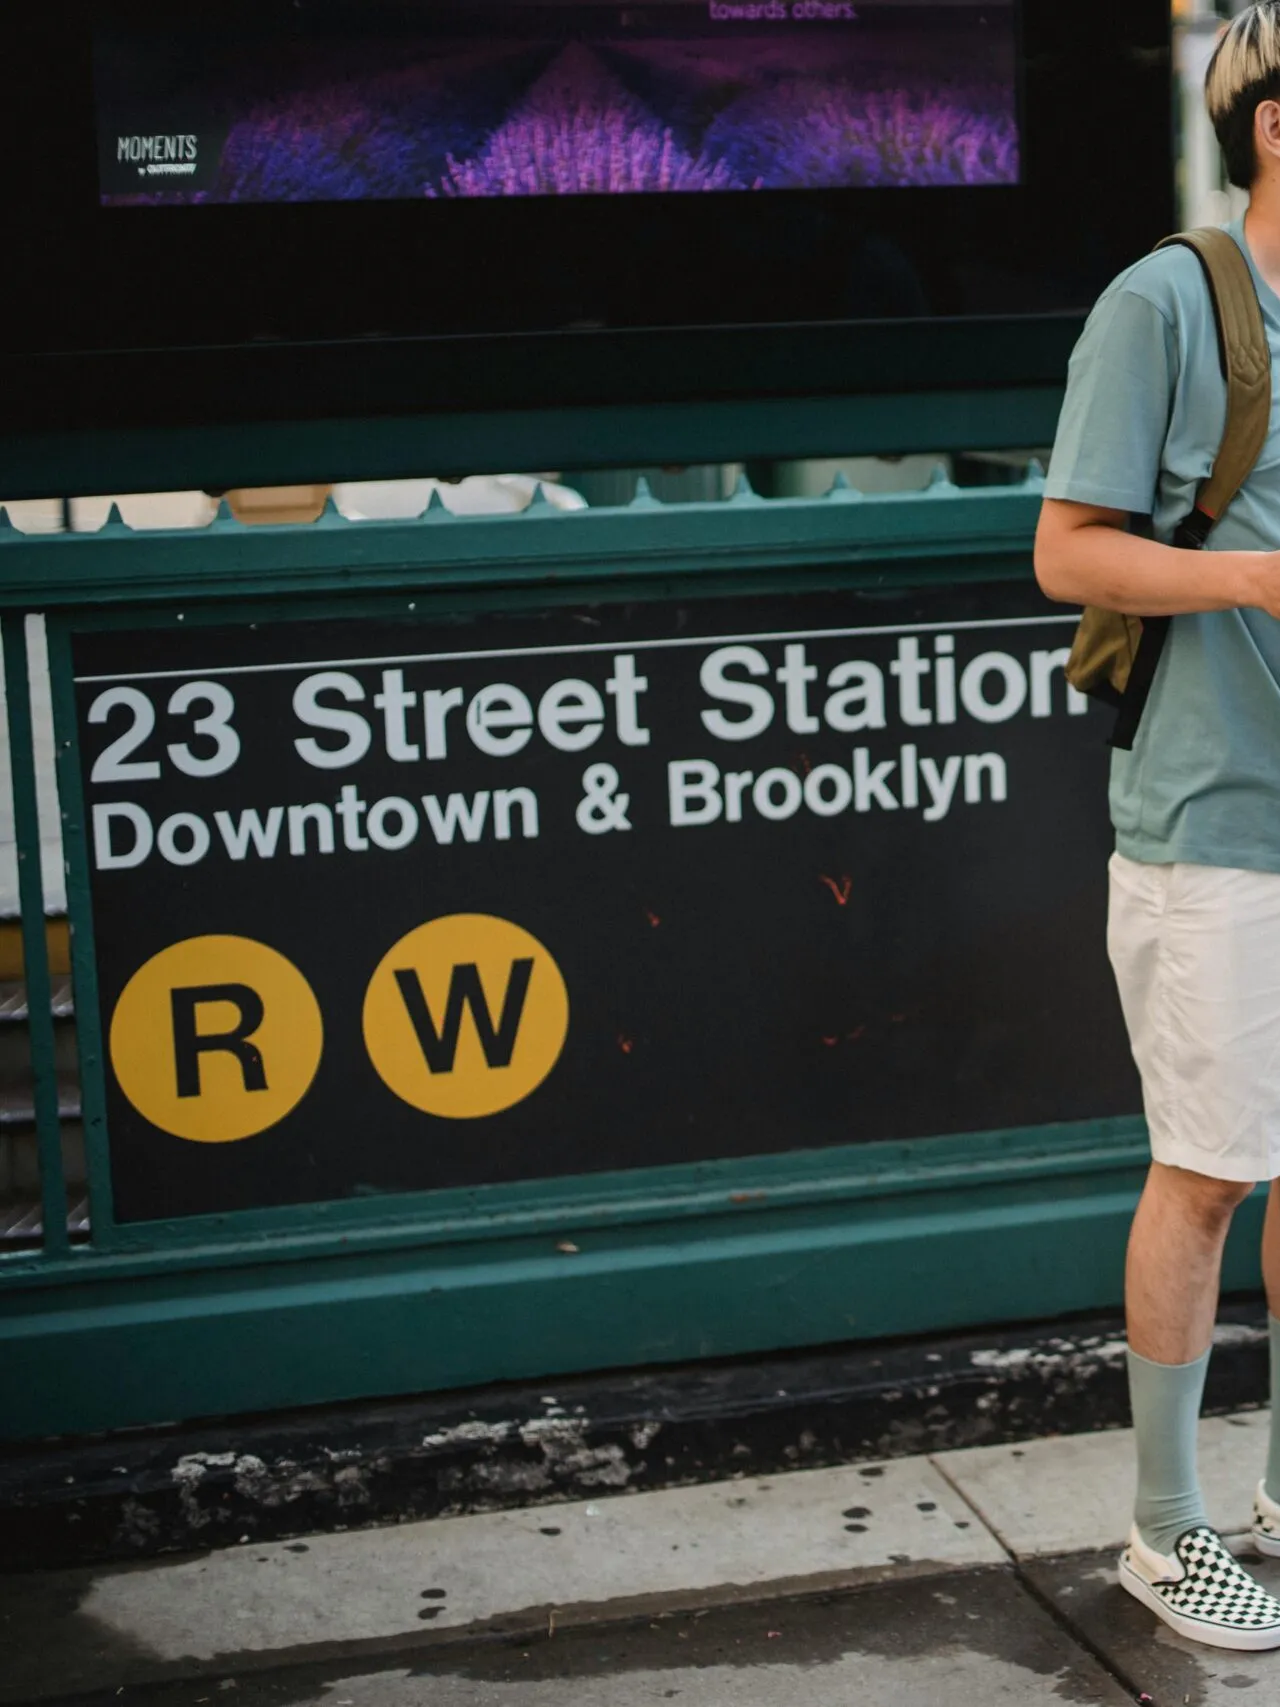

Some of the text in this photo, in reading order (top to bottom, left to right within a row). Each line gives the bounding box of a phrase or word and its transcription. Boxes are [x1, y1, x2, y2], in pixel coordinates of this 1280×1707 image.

[709, 0, 786, 19] towards
[117, 134, 199, 162] MOMENTS
[86, 636, 1087, 783] 23 Street Station
[92, 744, 1007, 870] Downtown & Brooklyn
[170, 957, 535, 1098] R W
